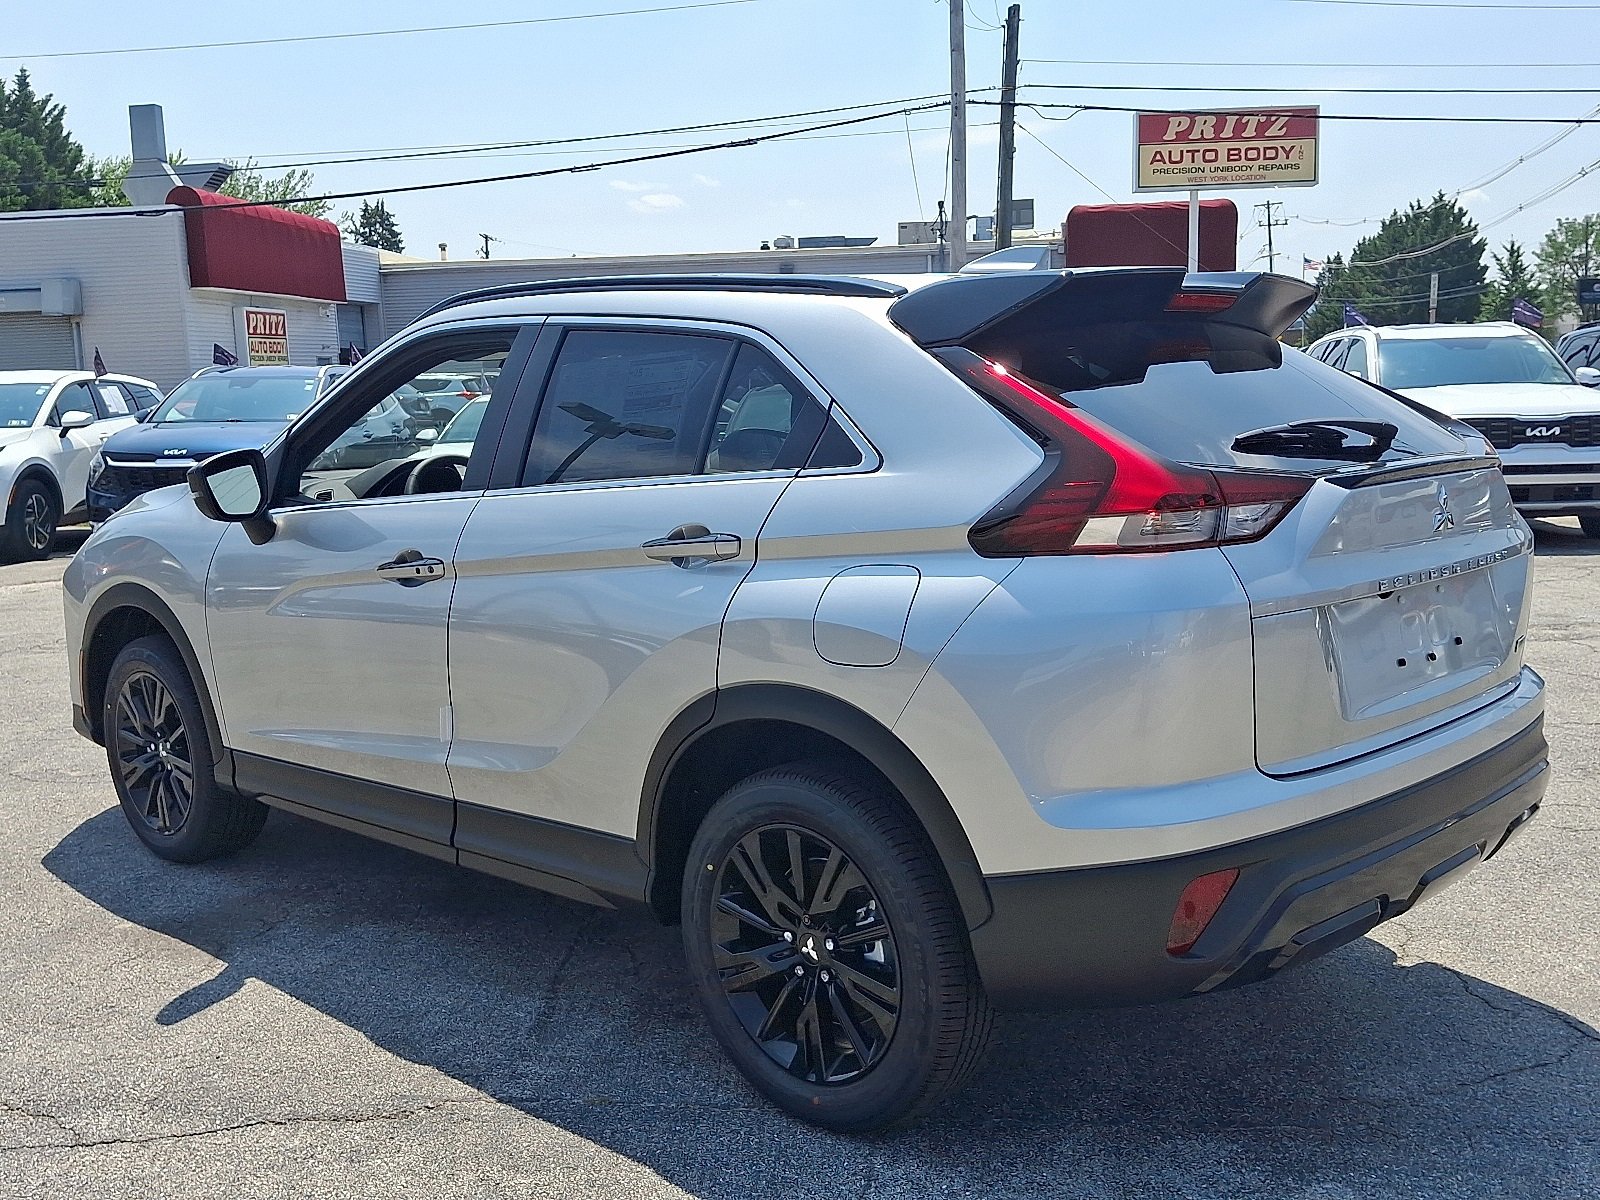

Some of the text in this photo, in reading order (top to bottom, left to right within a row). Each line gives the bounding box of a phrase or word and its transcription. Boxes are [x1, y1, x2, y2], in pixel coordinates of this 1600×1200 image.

[1162, 113, 1293, 141] PRITZ
[1150, 148, 1219, 165] AUTO
[1226, 145, 1296, 162] BODY
[1152, 163, 1301, 175] PRECISION UNIBODY REPAIRS
[248, 313, 285, 335] PRITZ
[250, 341, 285, 354] AUTO BODY
[1525, 426, 1561, 437] KIA
